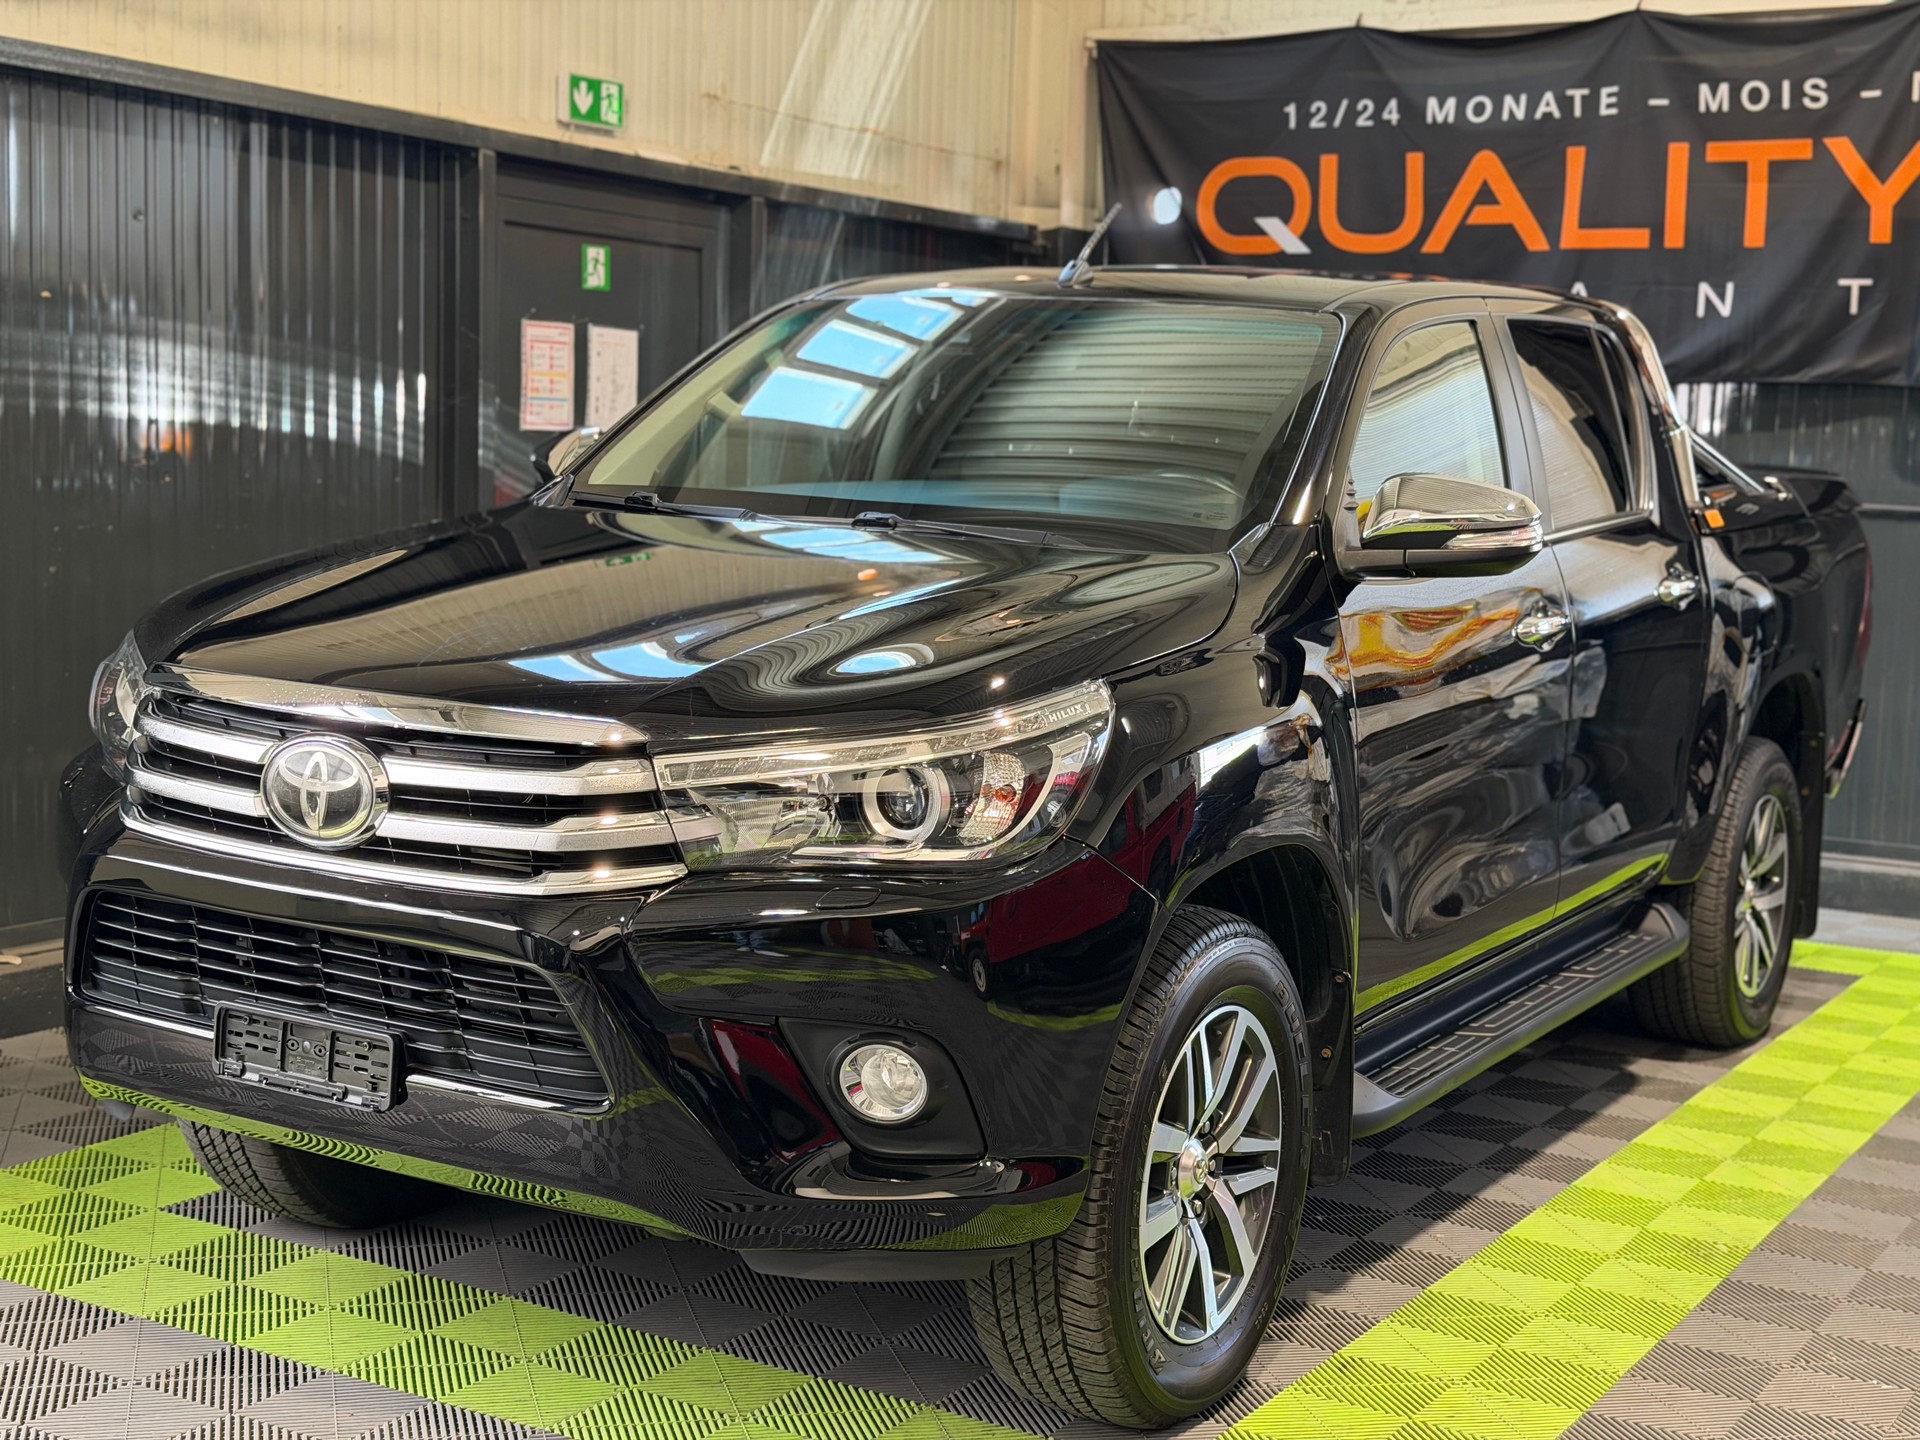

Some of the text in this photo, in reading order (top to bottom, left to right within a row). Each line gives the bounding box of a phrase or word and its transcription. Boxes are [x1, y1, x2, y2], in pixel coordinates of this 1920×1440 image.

[1284, 98, 1401, 129] 12/24
[1426, 86, 1620, 124] MONATE
[1698, 77, 1830, 113] MOIS
[1197, 137, 1920, 255] QUALITY
[1048, 704, 1084, 723] HILUX
